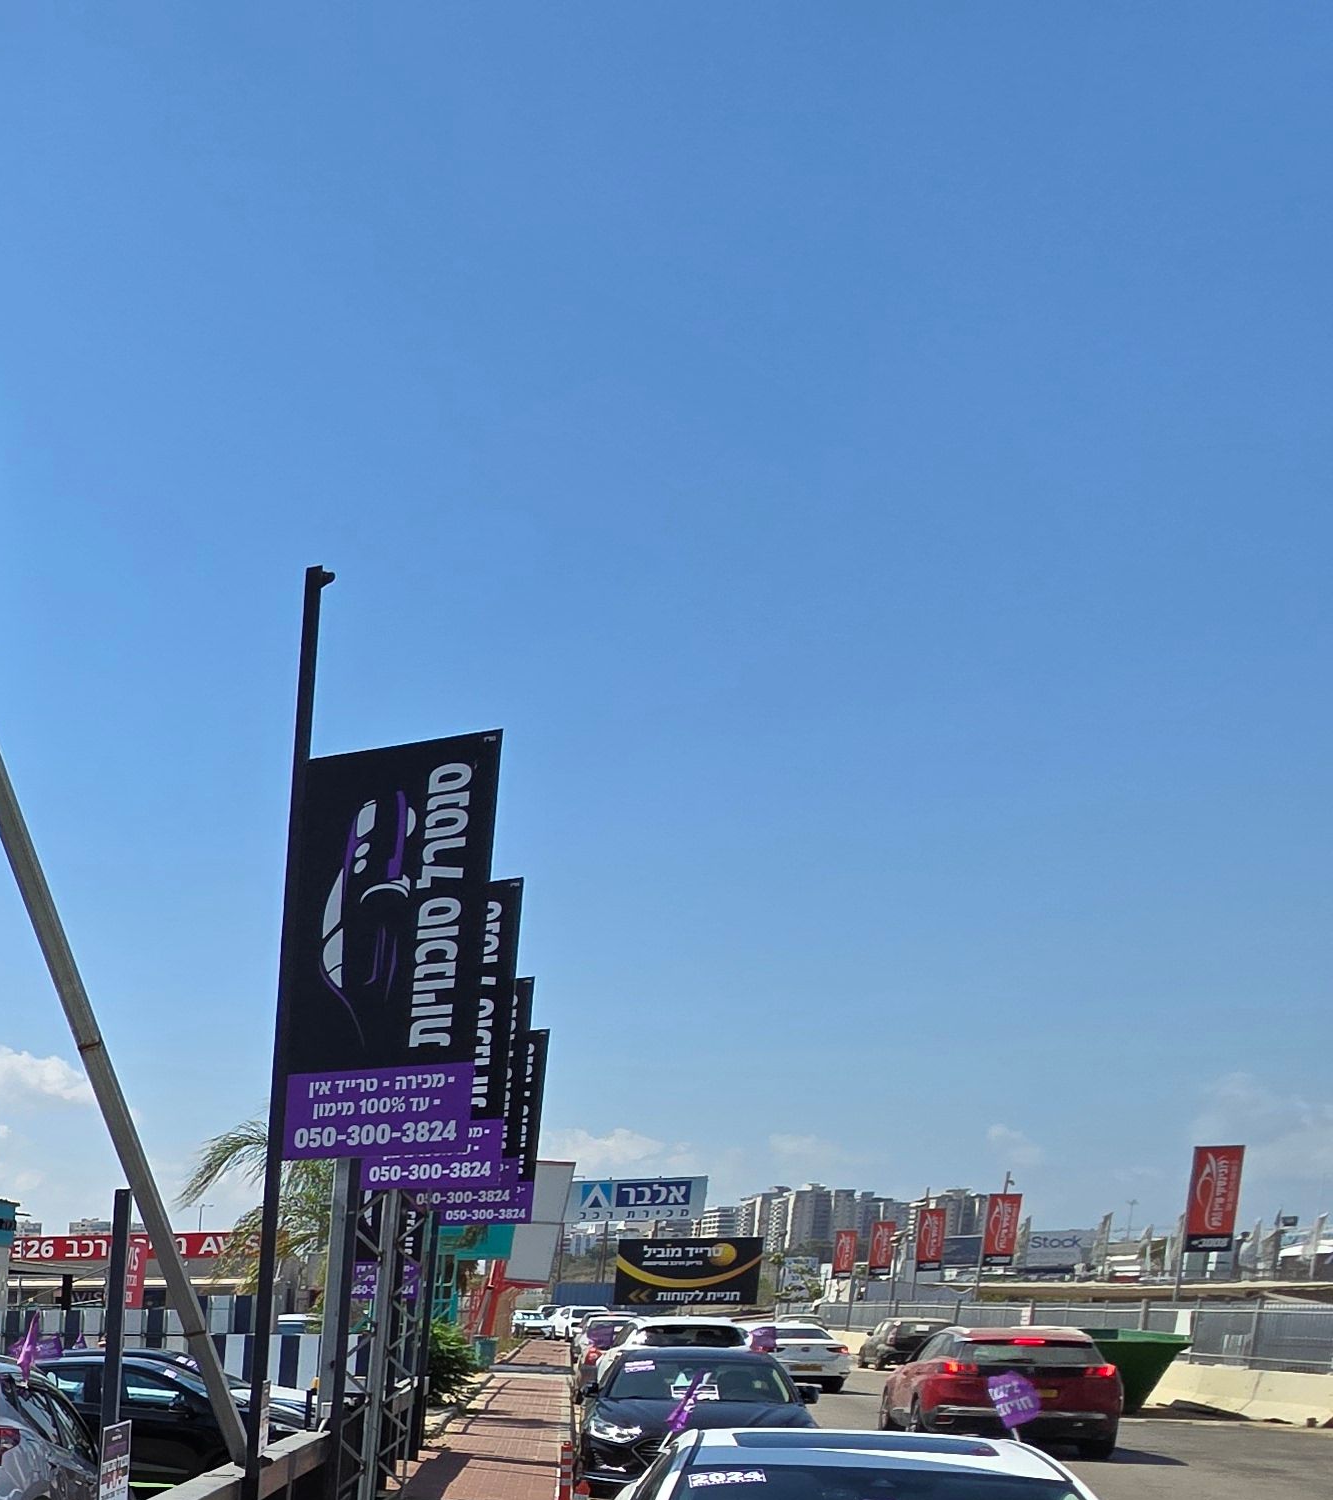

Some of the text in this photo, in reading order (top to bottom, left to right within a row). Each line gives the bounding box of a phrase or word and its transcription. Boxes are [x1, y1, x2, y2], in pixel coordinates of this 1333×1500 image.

[408, 761, 473, 1048] סנטרל סוכנויות
[307, 1073, 445, 1098] מכירה טרייד אין
[312, 1096, 430, 1119] עד 100% מימון
[293, 1121, 457, 1148] 050-300-3824
[369, 1161, 491, 1182] 050-300-3824
[621, 1184, 687, 1207] אלבר
[445, 1209, 526, 1221] 050-300-3824
[579, 1209, 690, 1220] מכירת רכב
[1030, 1235, 1081, 1249] Stock
[691, 1470, 762, 1486] 2024
